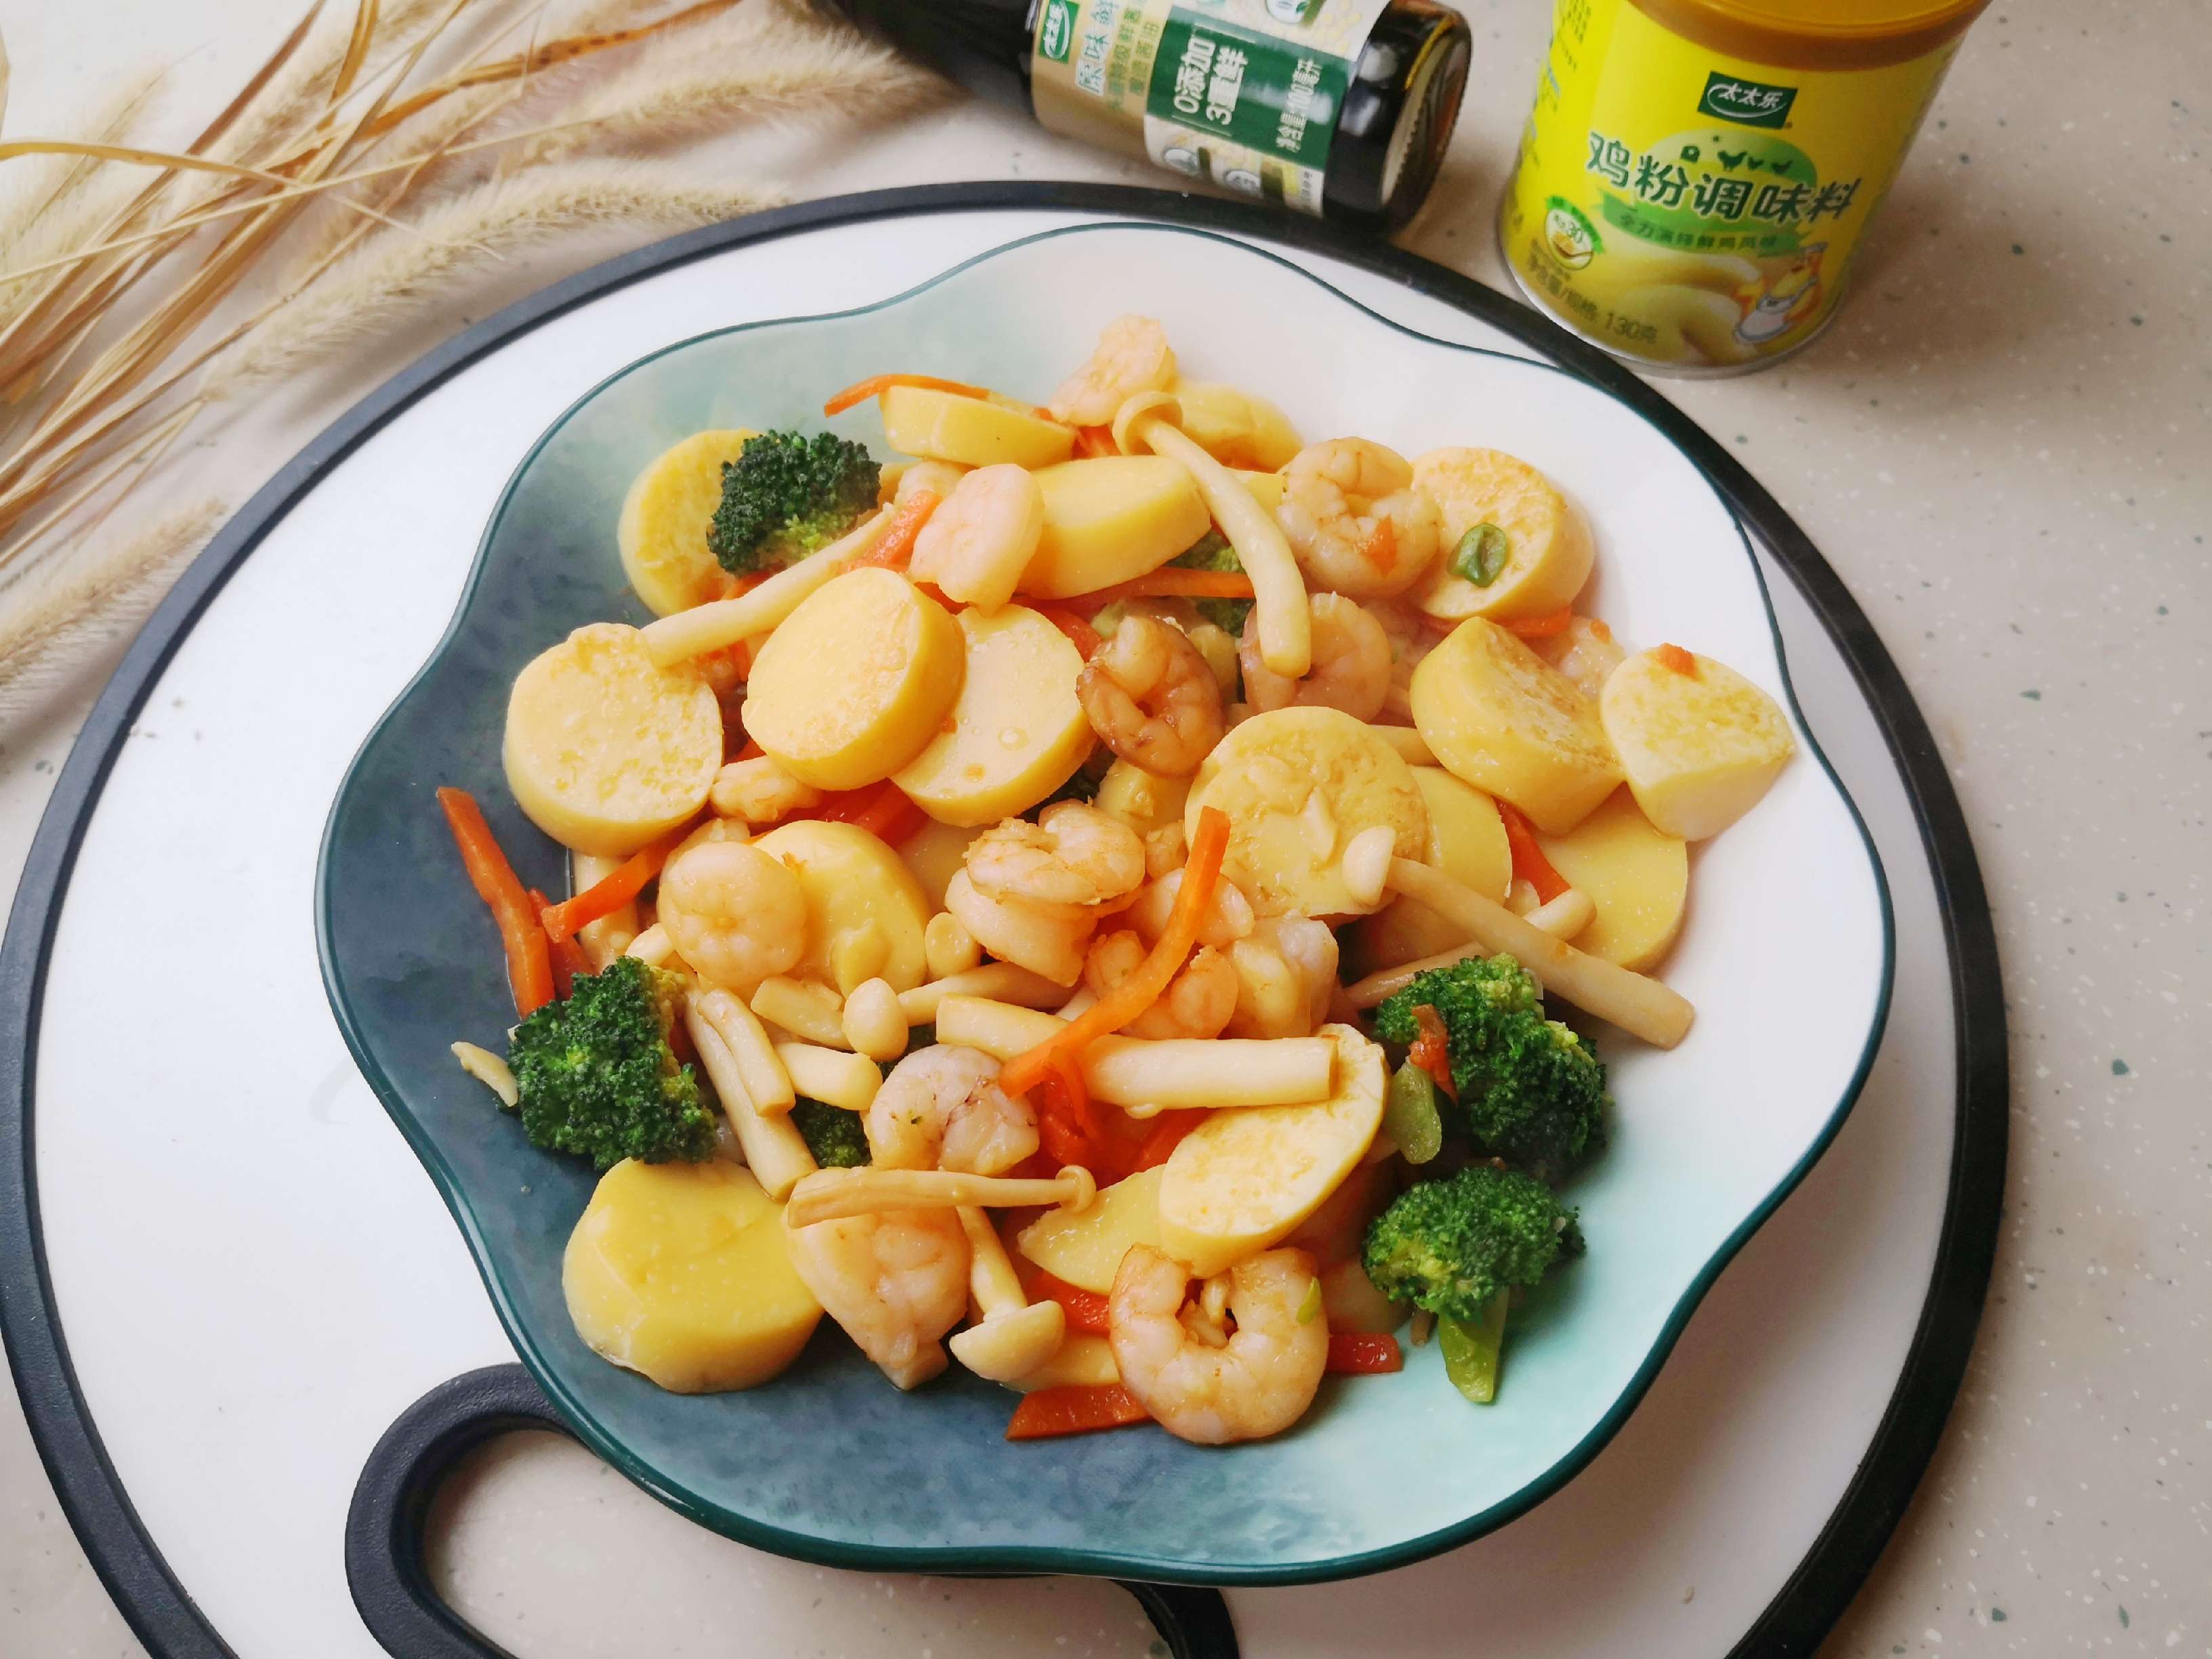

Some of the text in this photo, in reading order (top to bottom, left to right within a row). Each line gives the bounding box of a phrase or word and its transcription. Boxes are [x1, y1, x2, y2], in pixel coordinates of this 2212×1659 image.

[1173, 35, 1216, 114] 0添加
[1206, 45, 1248, 125] 3重鲜
[1717, 83, 1783, 109] 太太乐
[1587, 131, 1863, 225] 鸡粉调味料
